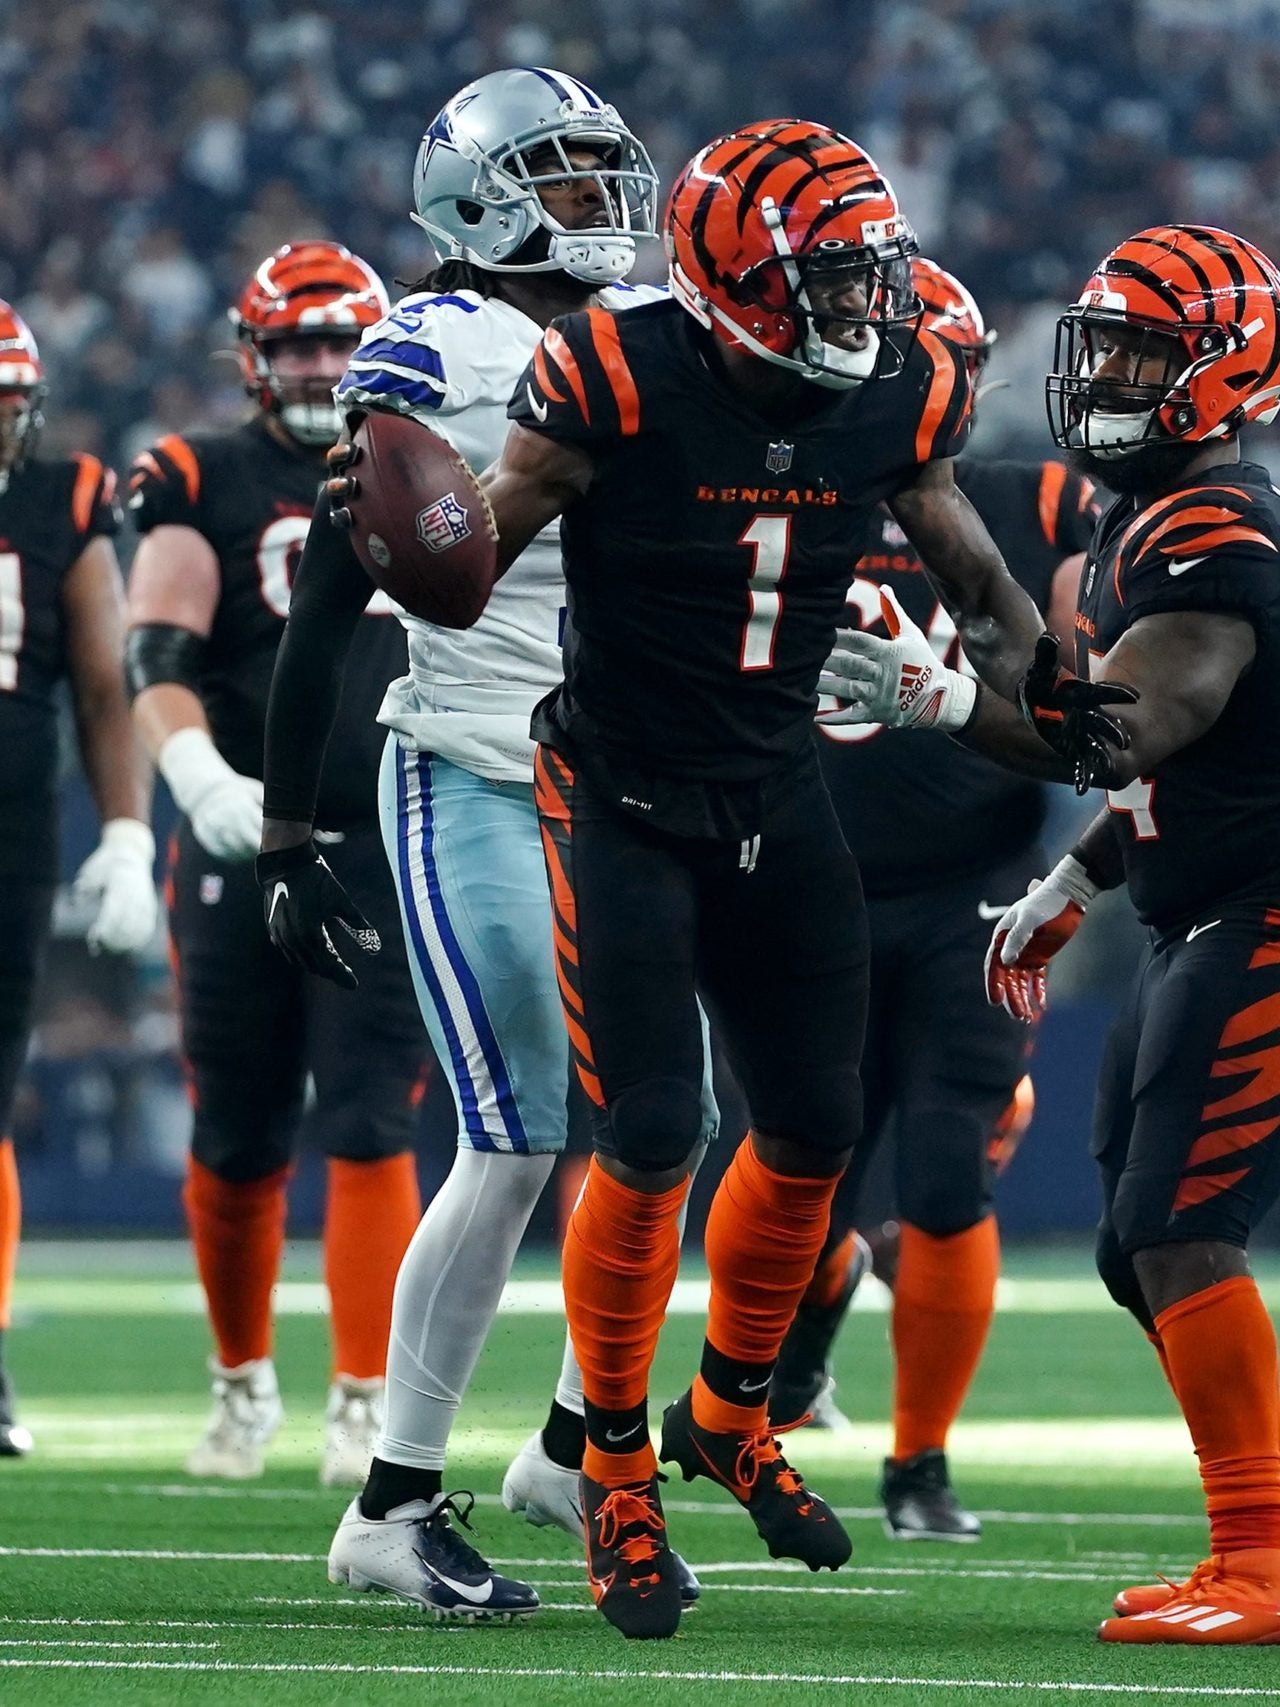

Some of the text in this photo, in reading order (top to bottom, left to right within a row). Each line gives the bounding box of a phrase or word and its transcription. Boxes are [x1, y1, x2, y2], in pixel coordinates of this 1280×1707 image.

[696, 485, 838, 504] BENGALS
[422, 508, 453, 548] NFL
[737, 513, 793, 672] 1
[900, 665, 932, 712] adidas
